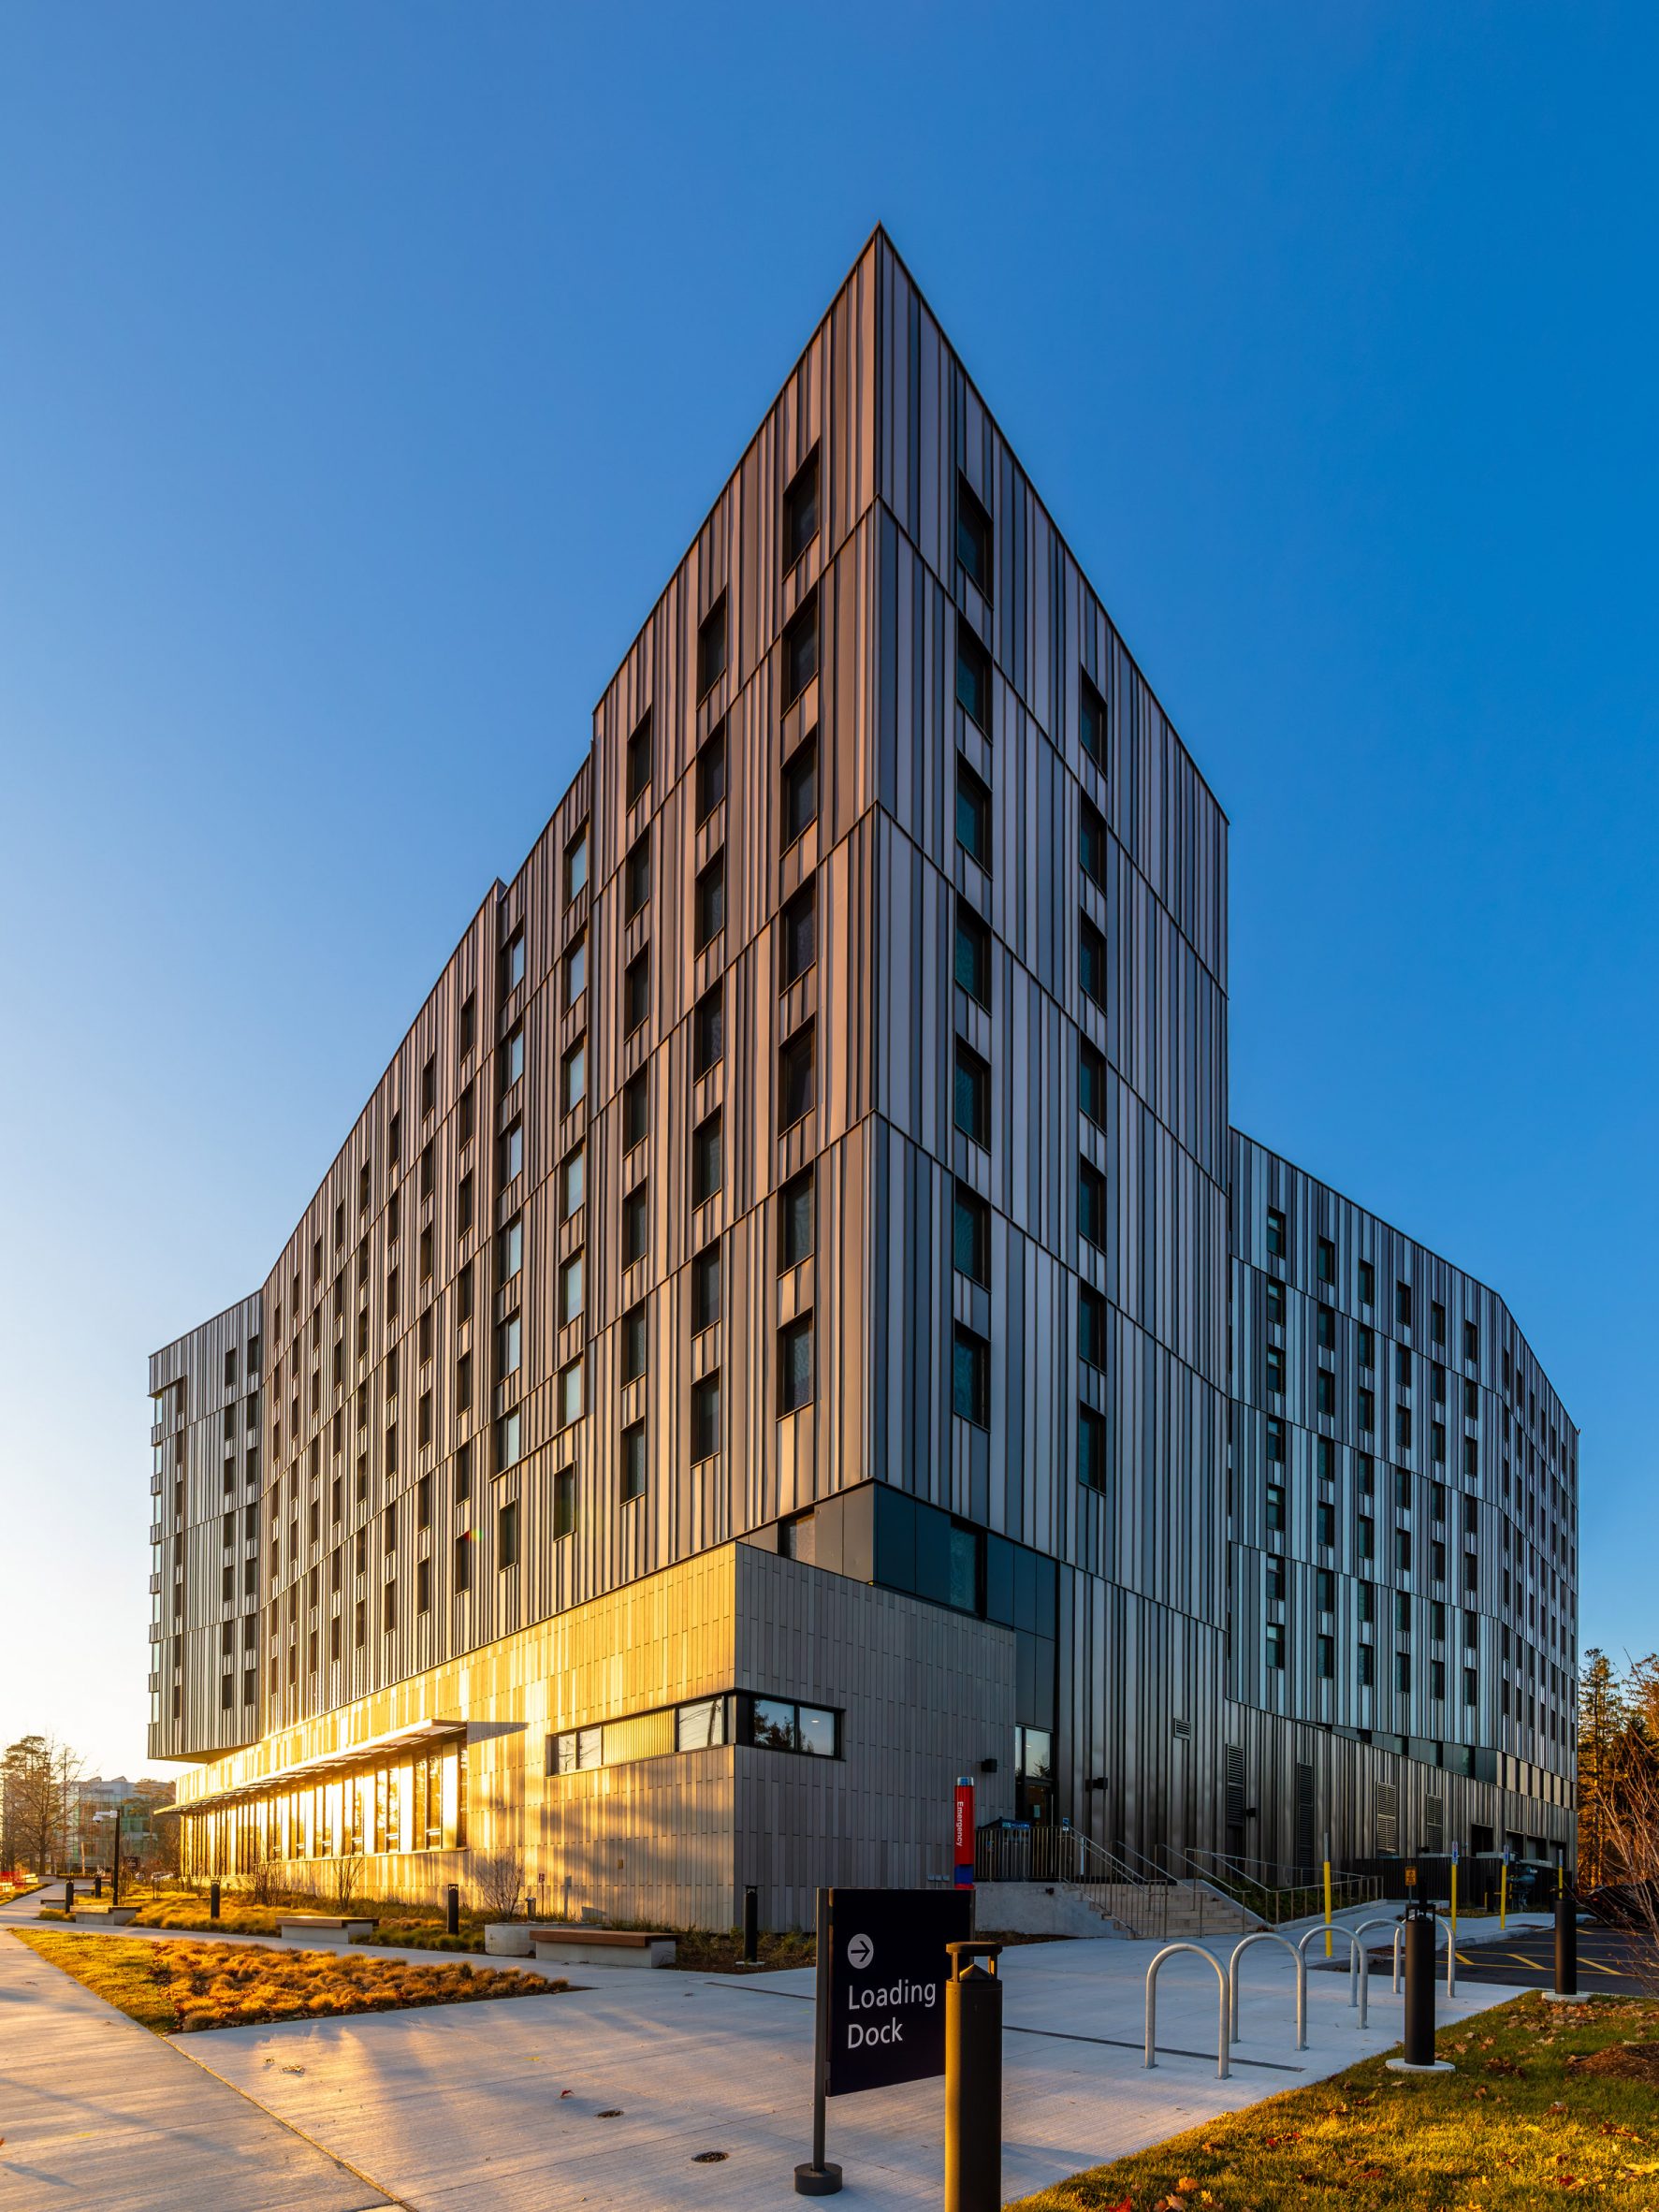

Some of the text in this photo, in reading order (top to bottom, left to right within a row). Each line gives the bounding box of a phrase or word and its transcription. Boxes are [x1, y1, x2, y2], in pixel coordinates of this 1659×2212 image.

[955, 1801, 964, 1847] Emergency
[848, 1979, 936, 2010] Loading
[847, 2017, 903, 2048] Dock
